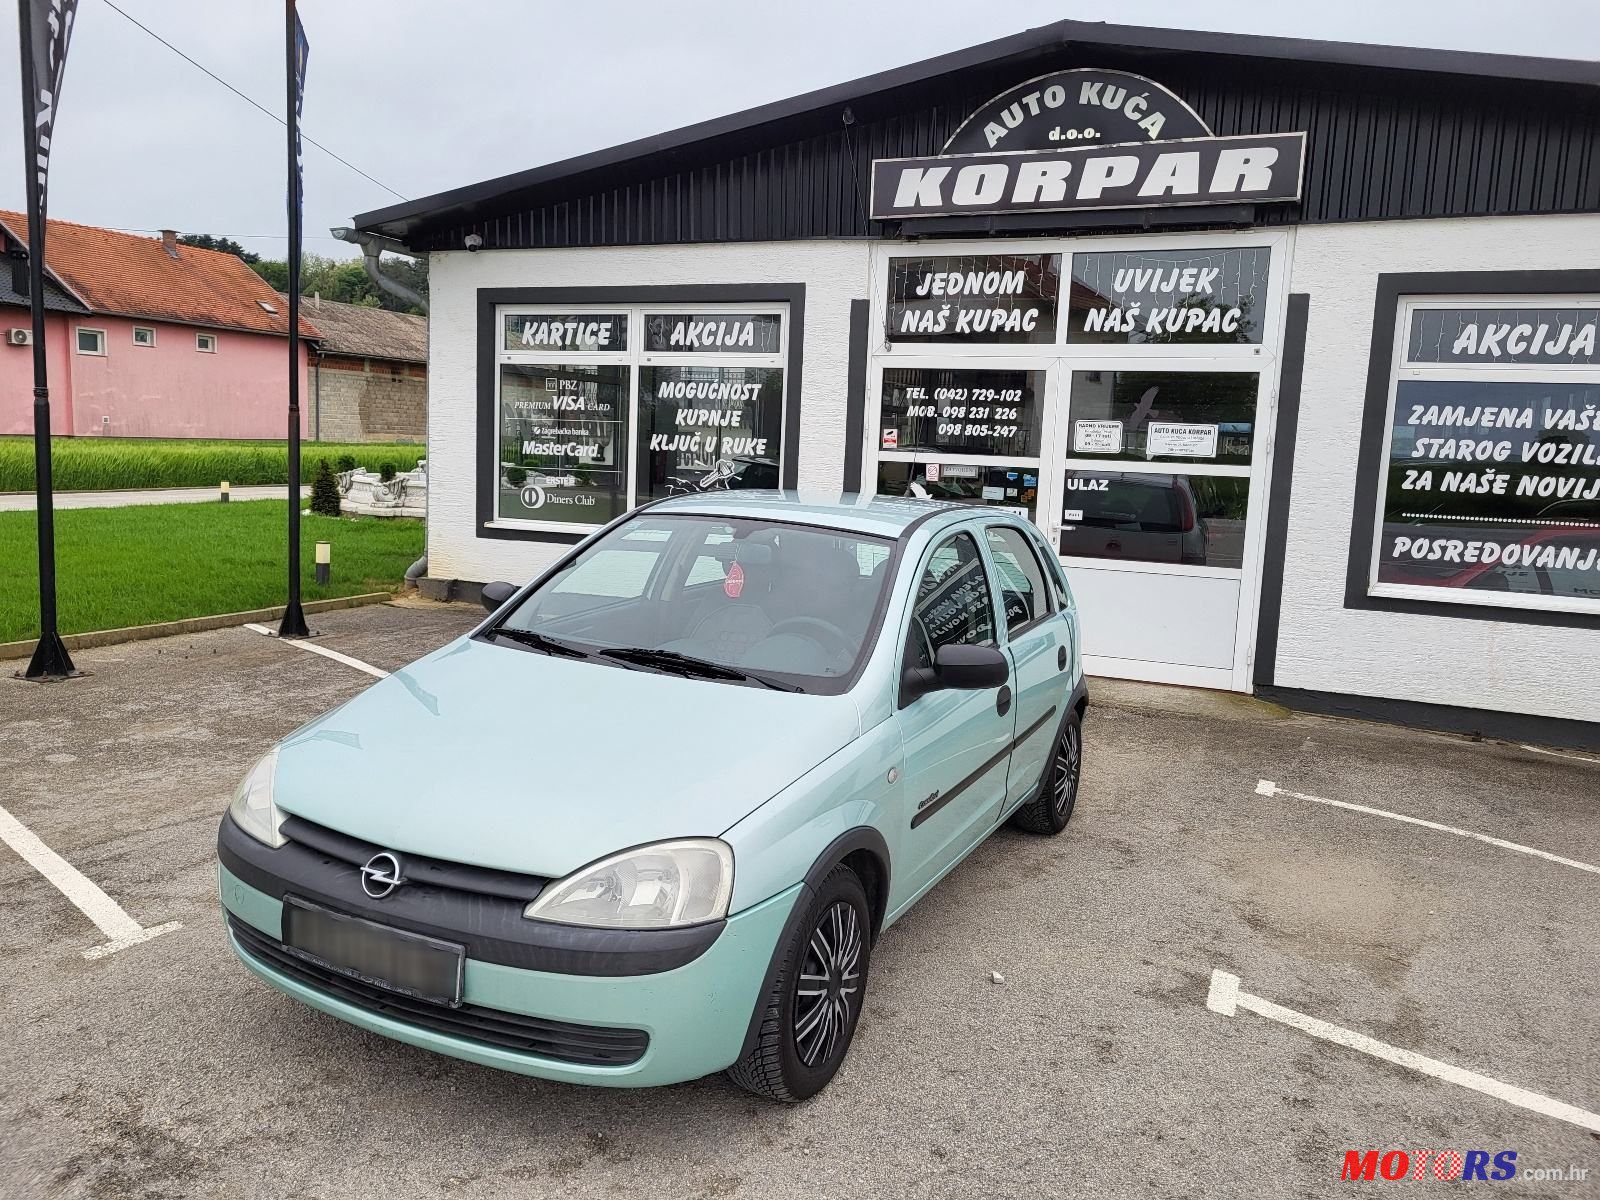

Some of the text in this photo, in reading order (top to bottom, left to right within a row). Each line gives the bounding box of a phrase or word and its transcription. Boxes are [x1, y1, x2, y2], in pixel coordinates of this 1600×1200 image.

[984, 81, 1166, 149] AUTO KUĆA
[1048, 126, 1101, 141] d.o.o.
[893, 147, 1279, 208] KORPAR
[916, 271, 1025, 296] JEDNOM
[1113, 267, 1220, 294] UVIJEK
[900, 304, 1039, 334] NAŠ KUPAC
[1084, 302, 1241, 334] NAŠ KUPAC
[521, 322, 612, 347] KARTICE
[670, 322, 754, 347] AKCIJA
[1452, 323, 1596, 356] AKCIJA
[560, 380, 578, 390] PBZ
[658, 379, 762, 401] MOGUĆNOST
[906, 387, 1022, 402] TEL. (042) 729-102
[514, 395, 611, 411] PREMIUM VISA CARD
[906, 405, 1017, 420] MOB. 098 231 226
[675, 408, 742, 427] KUPNJE
[1408, 405, 1533, 429] ZAMJENA
[938, 423, 1018, 438] 098 805-247
[650, 431, 768, 456] KLJUČ U RUKE
[1411, 437, 1600, 466] STAROG VOZIL
[1067, 478, 1109, 491] ULAZ
[1401, 469, 1433, 491] ZA
[1440, 468, 1511, 495] NAŠE
[547, 493, 596, 506] Diners Club
[1392, 536, 1600, 572] POSREDOVANJ
